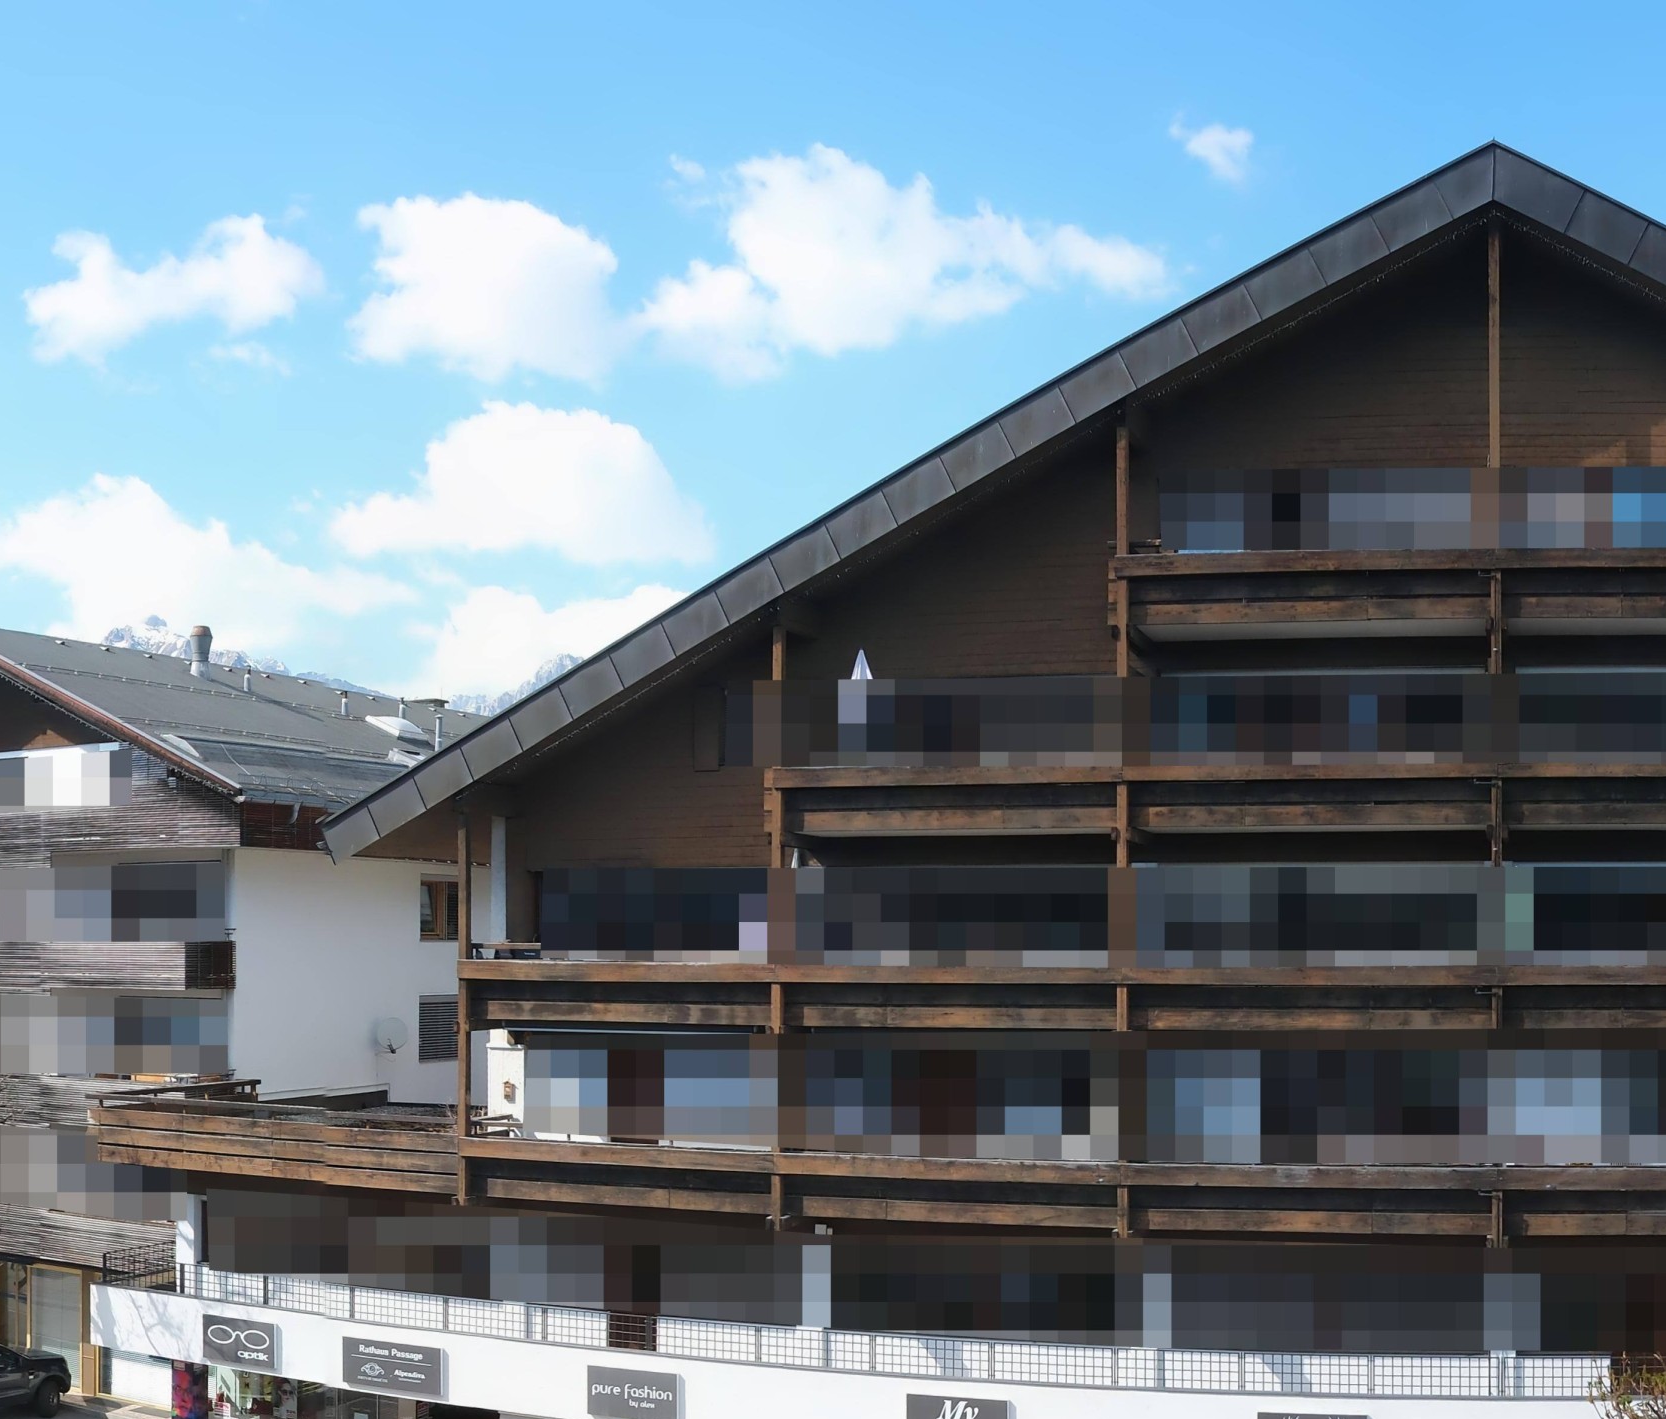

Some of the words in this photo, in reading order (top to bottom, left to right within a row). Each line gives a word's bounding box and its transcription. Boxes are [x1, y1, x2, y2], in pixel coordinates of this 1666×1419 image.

[237, 1350, 269, 1362] optik
[359, 1344, 389, 1356] Rathaus
[391, 1348, 423, 1361] Passage
[394, 1368, 426, 1379] Alpendiva
[591, 1383, 621, 1396] pure
[624, 1383, 672, 1401] fashion
[629, 1400, 639, 1408] by
